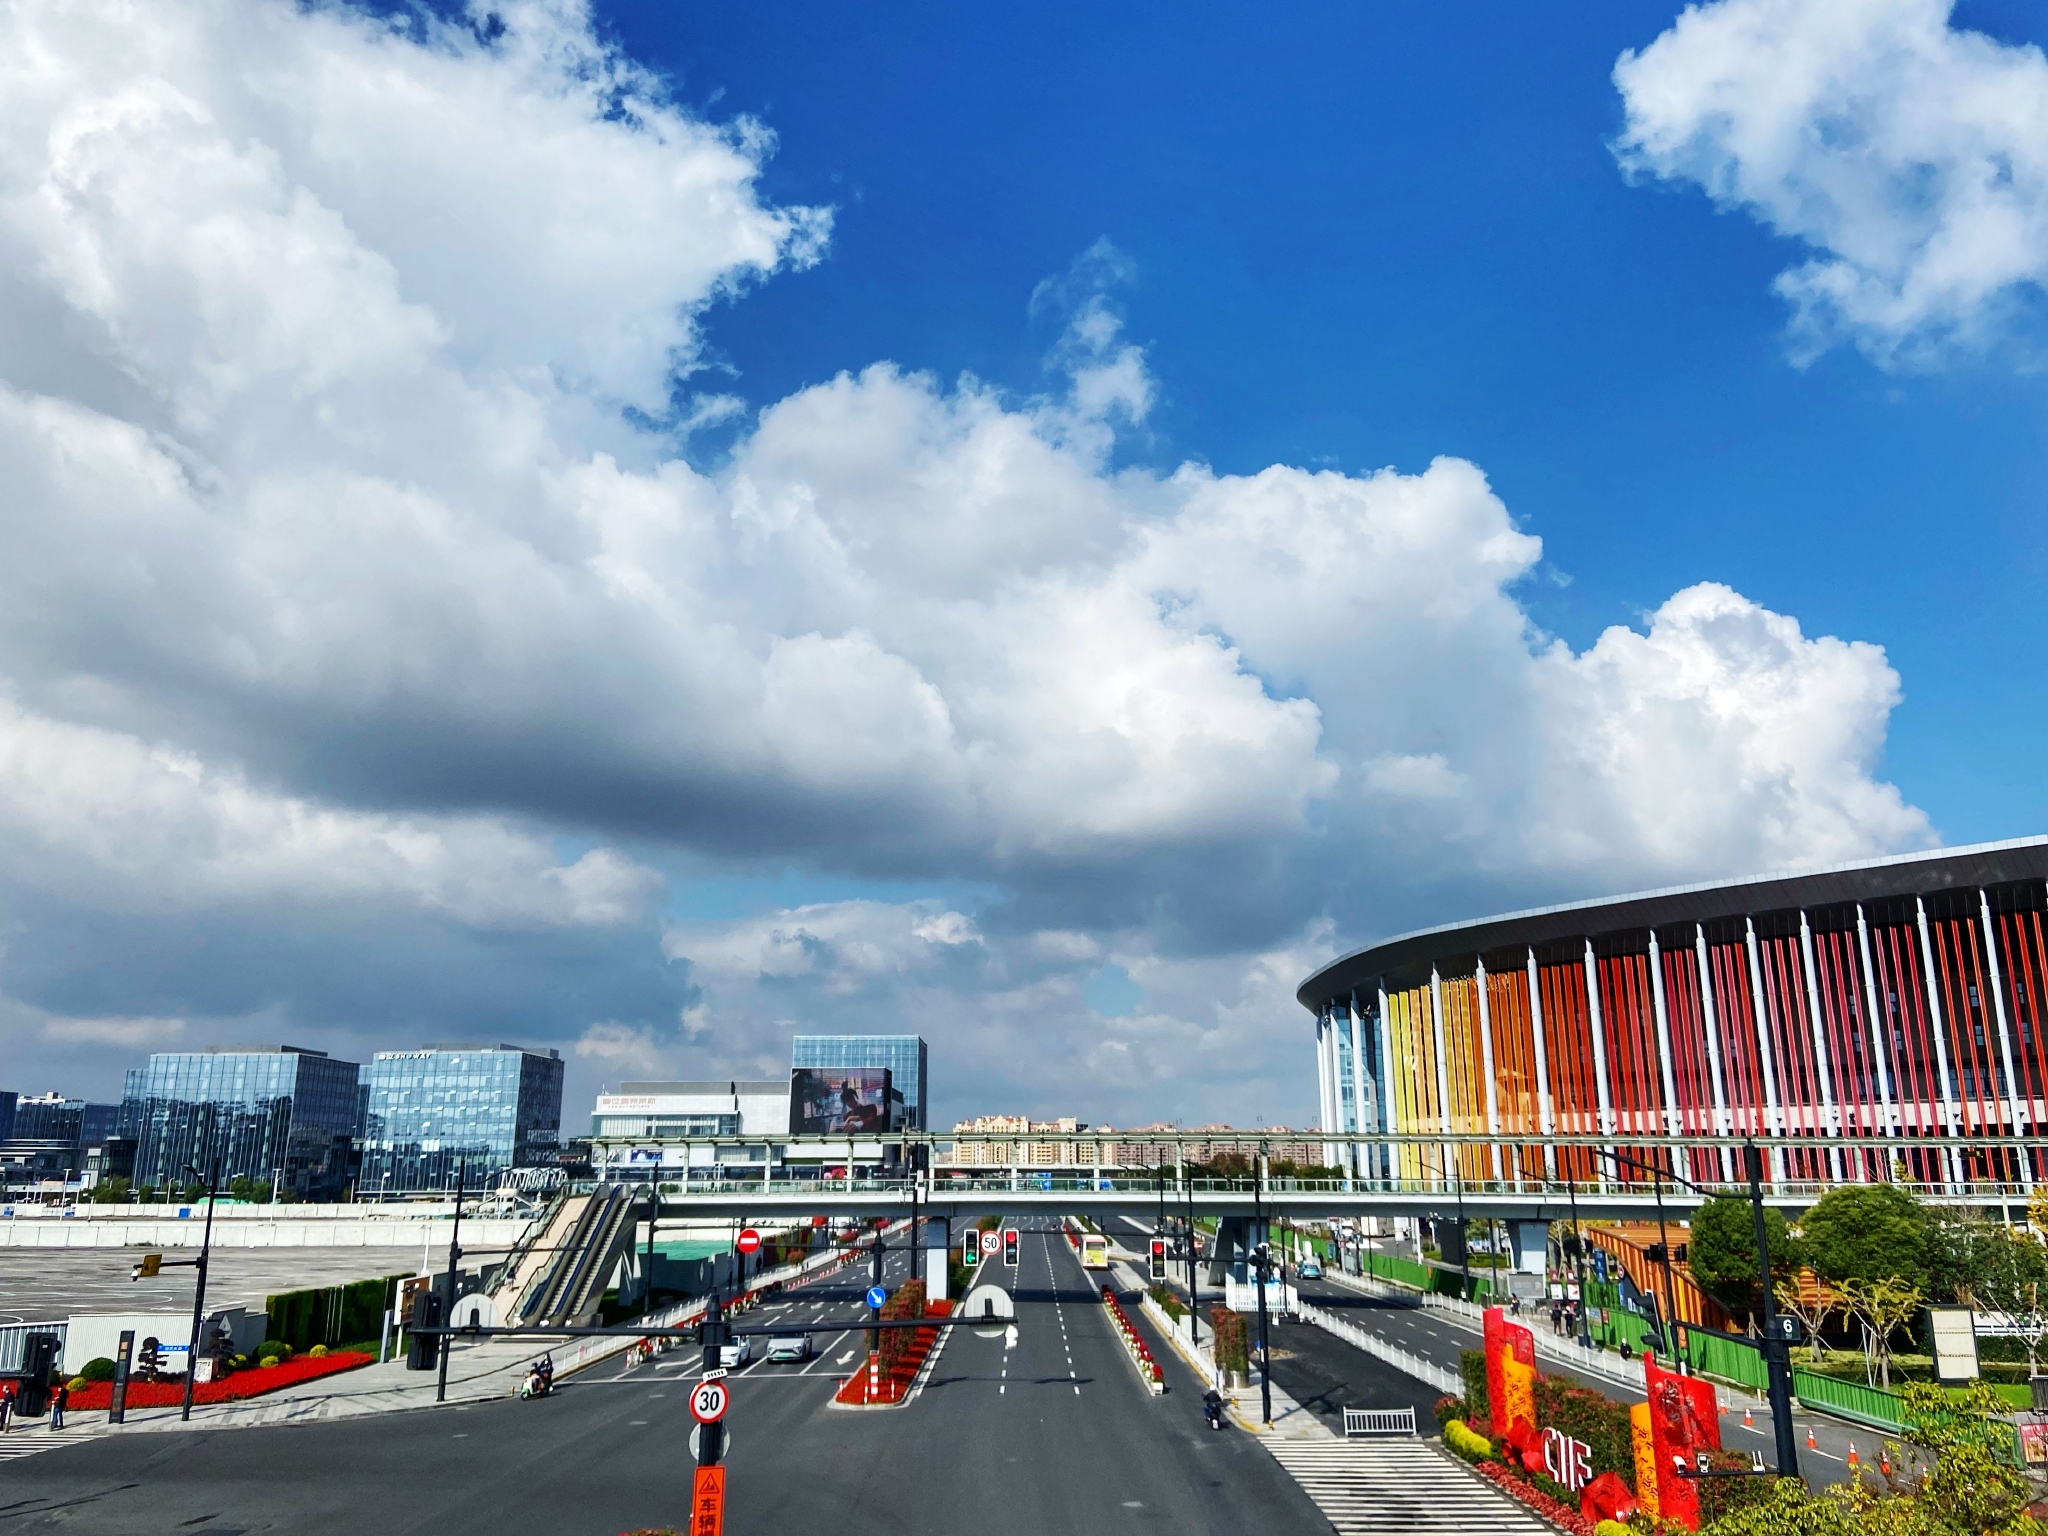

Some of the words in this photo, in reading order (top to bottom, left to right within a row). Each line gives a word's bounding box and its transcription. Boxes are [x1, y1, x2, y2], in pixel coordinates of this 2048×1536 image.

[984, 1237, 997, 1249] 50
[1783, 1319, 1793, 1333] 6
[699, 1391, 720, 1411] 30
